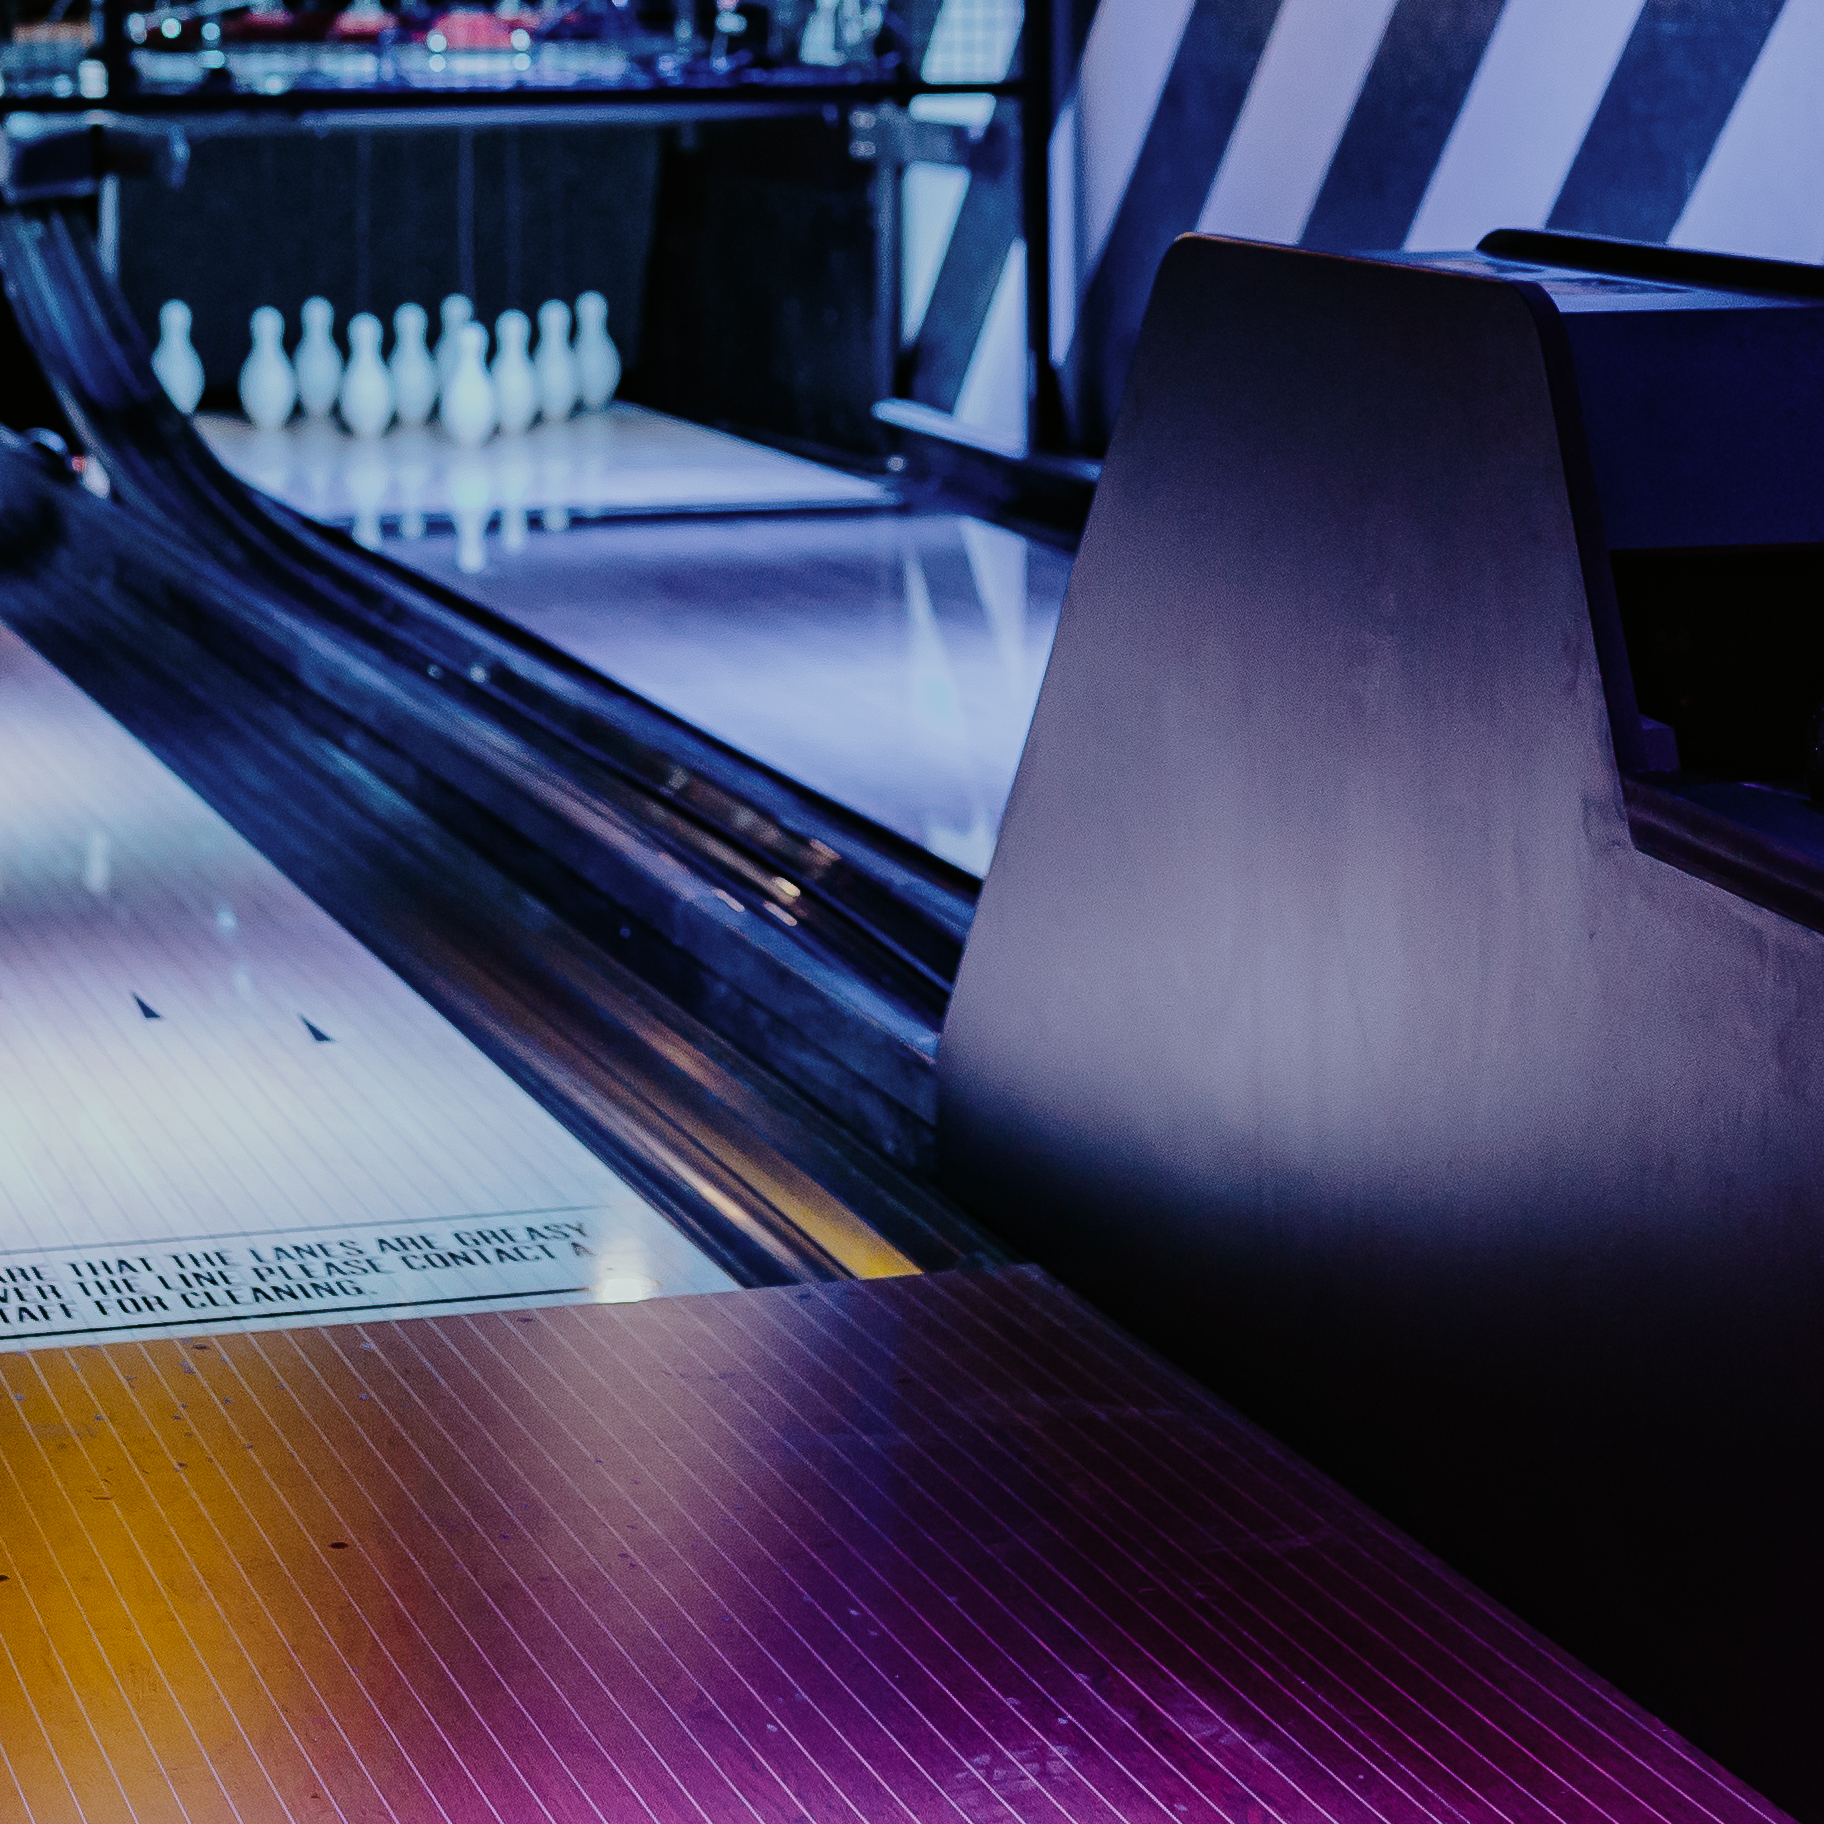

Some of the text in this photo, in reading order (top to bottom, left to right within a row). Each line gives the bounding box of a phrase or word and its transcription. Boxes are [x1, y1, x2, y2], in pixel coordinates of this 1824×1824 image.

[68, 1256, 156, 1278] THAT
[168, 1249, 235, 1270] THE
[249, 1240, 367, 1264] LANES
[377, 1233, 441, 1253] ARE
[454, 1223, 590, 1246] GREASY
[76, 1277, 143, 1298] THE
[157, 1270, 236, 1292] LINE
[251, 1259, 388, 1284] PLEASE
[401, 1243, 559, 1271] CONTACT
[93, 1295, 170, 1318] FOR
